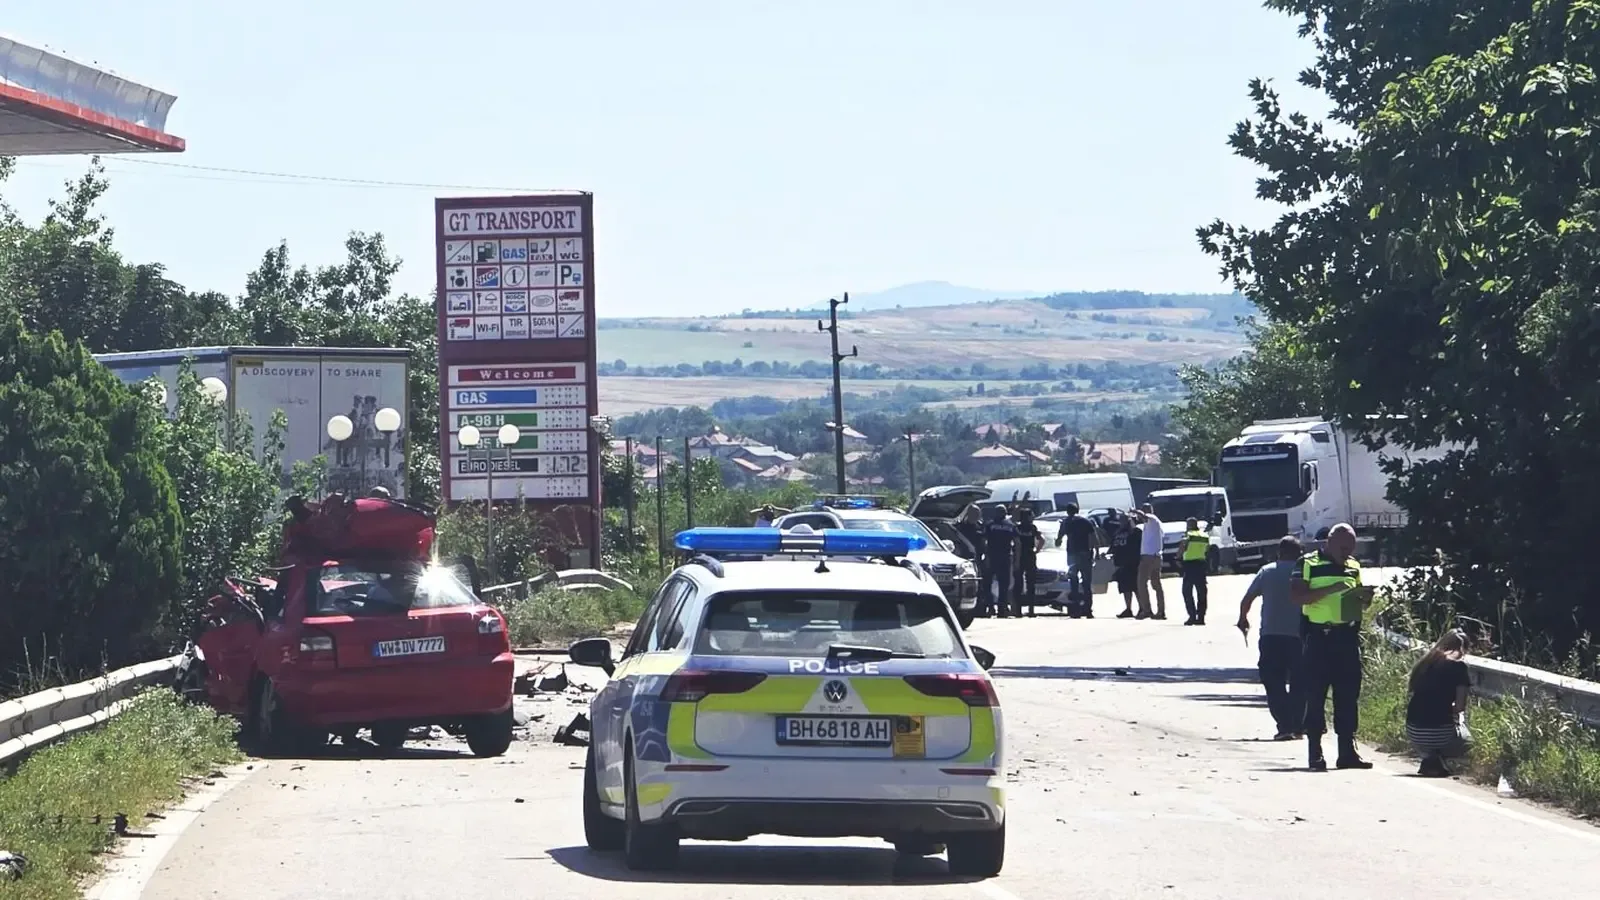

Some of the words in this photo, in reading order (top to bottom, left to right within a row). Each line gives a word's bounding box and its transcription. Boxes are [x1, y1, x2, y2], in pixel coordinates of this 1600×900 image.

[449, 212, 470, 232] GT
[475, 210, 577, 231] TRANSPORT
[502, 247, 526, 260] GAS
[560, 252, 580, 260] WC
[476, 267, 499, 286] SHOP
[561, 265, 572, 285] P
[508, 318, 523, 328] TIR
[570, 328, 584, 336] 24h
[241, 368, 248, 376] A
[252, 367, 315, 377] DISCOVERY
[327, 368, 341, 377] TO
[345, 368, 382, 378] SHARE
[479, 369, 554, 380] Welcome
[458, 391, 488, 405] GAS
[461, 415, 491, 427] A-98
[496, 414, 505, 426] H
[788, 659, 880, 675] POLICE
